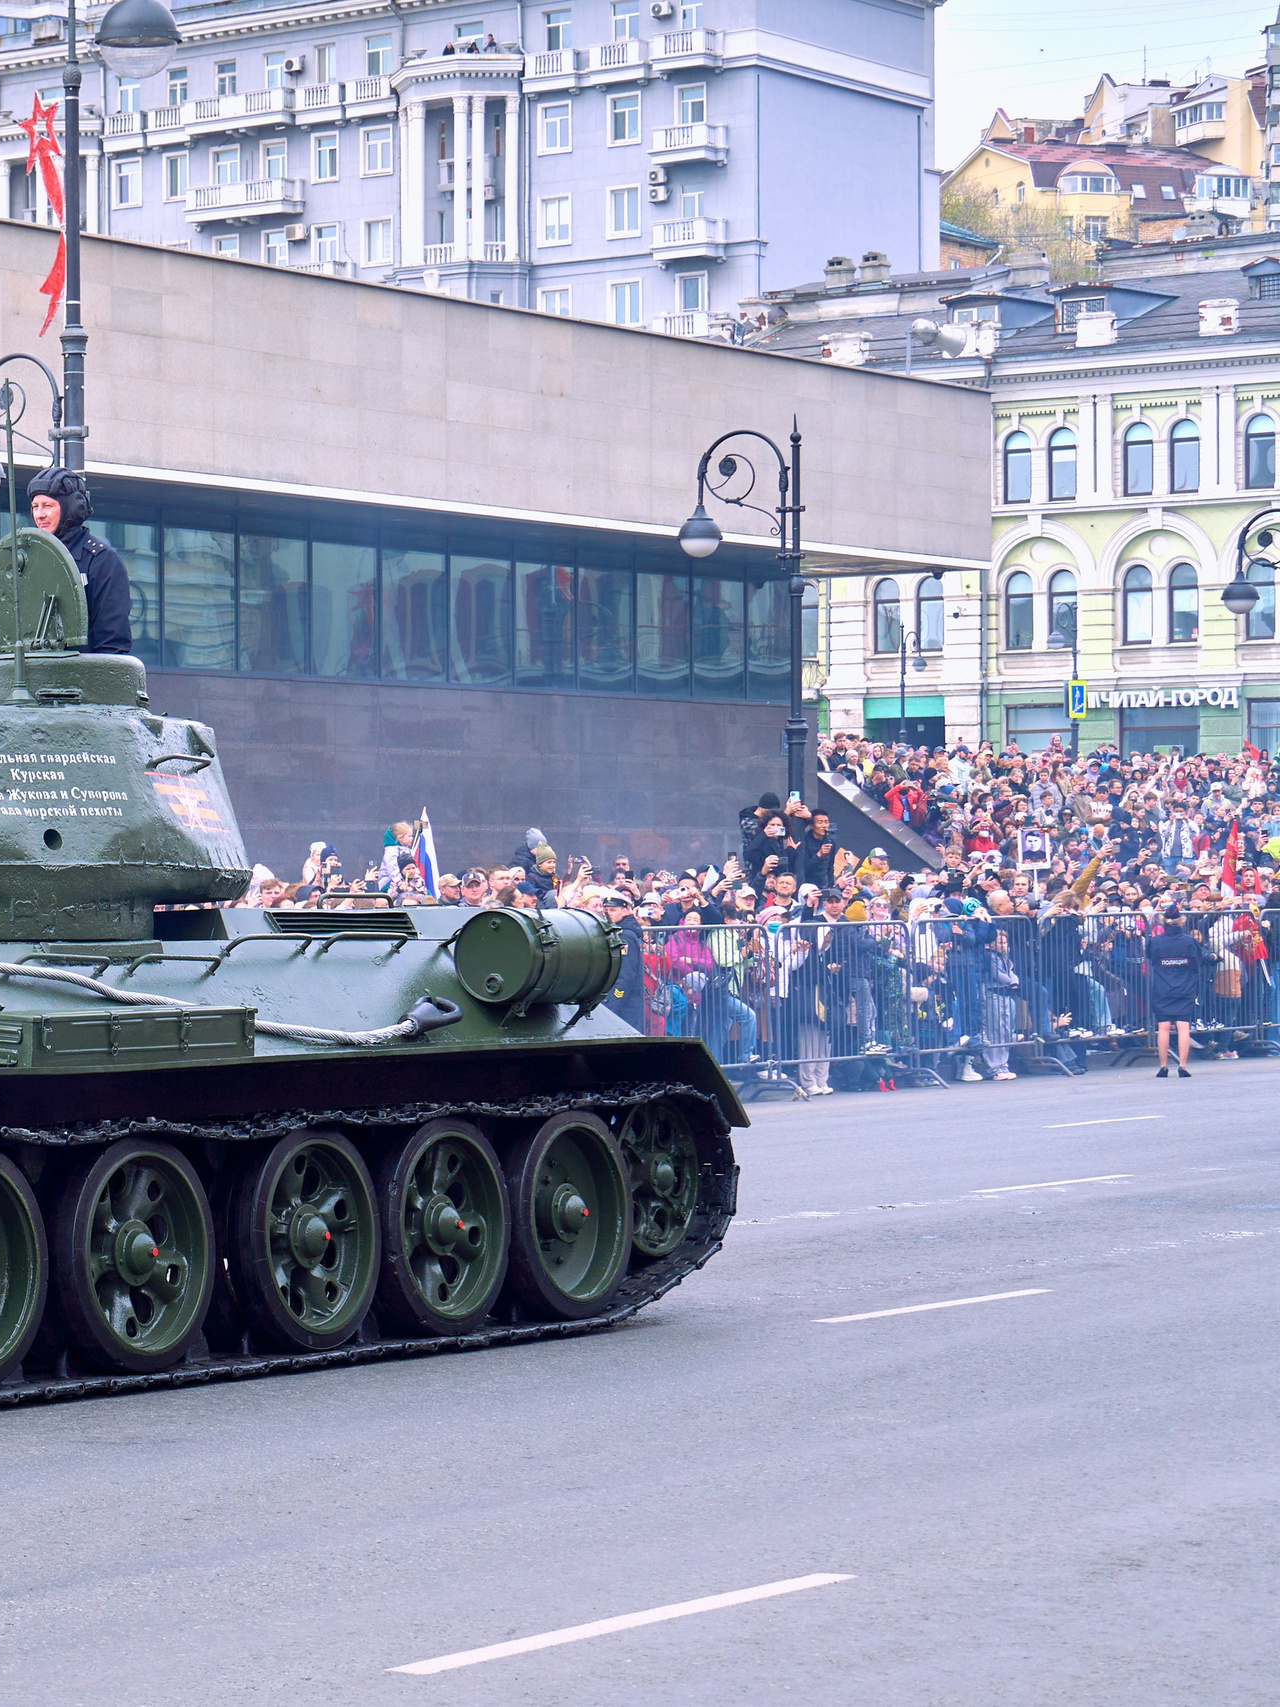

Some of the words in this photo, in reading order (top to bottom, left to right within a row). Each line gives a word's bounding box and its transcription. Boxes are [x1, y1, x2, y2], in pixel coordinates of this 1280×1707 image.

[1100, 686, 1239, 709] ЧИТАЙ-ГОРОД
[39, 751, 116, 766] гвардейская
[9, 768, 65, 784] Курская
[6, 787, 58, 804] Жукова
[60, 790, 69, 800] и
[70, 786, 129, 803] Суворова
[23, 804, 77, 820] морской
[79, 806, 123, 817] пехоты
